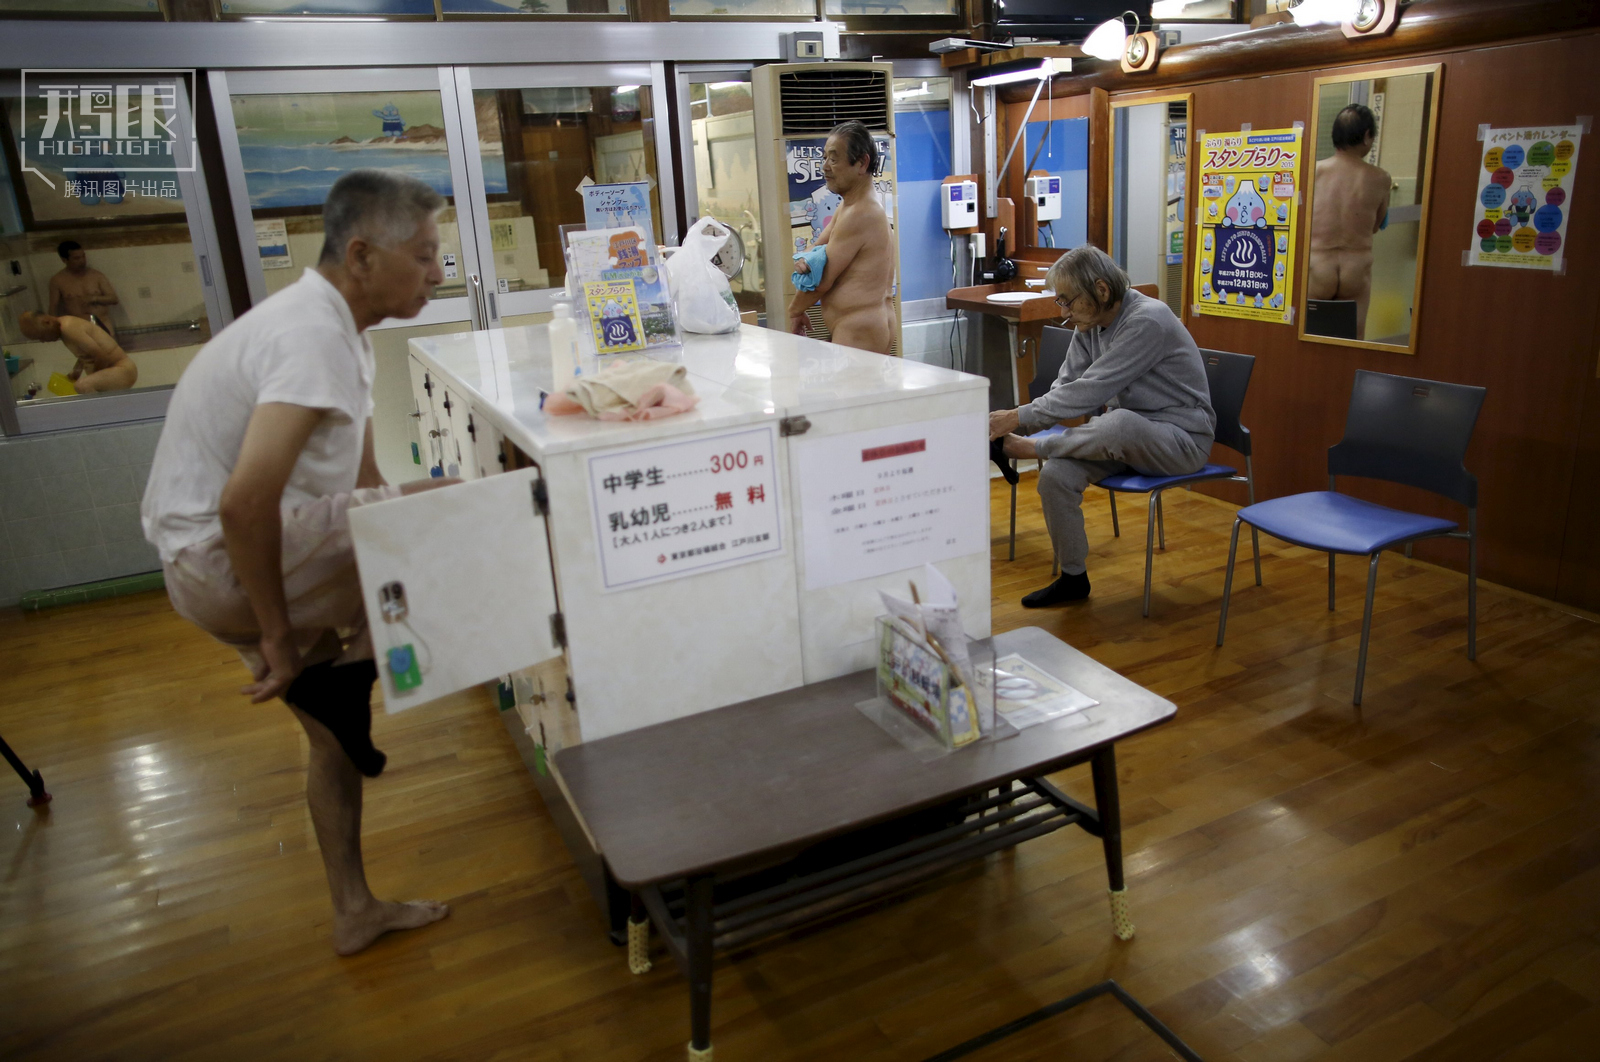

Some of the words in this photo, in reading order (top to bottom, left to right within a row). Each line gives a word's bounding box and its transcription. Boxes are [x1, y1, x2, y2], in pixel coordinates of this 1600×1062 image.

[793, 145, 823, 158] LET'S
[603, 466, 665, 494] 中学生
[608, 502, 671, 532] 乳幼児
